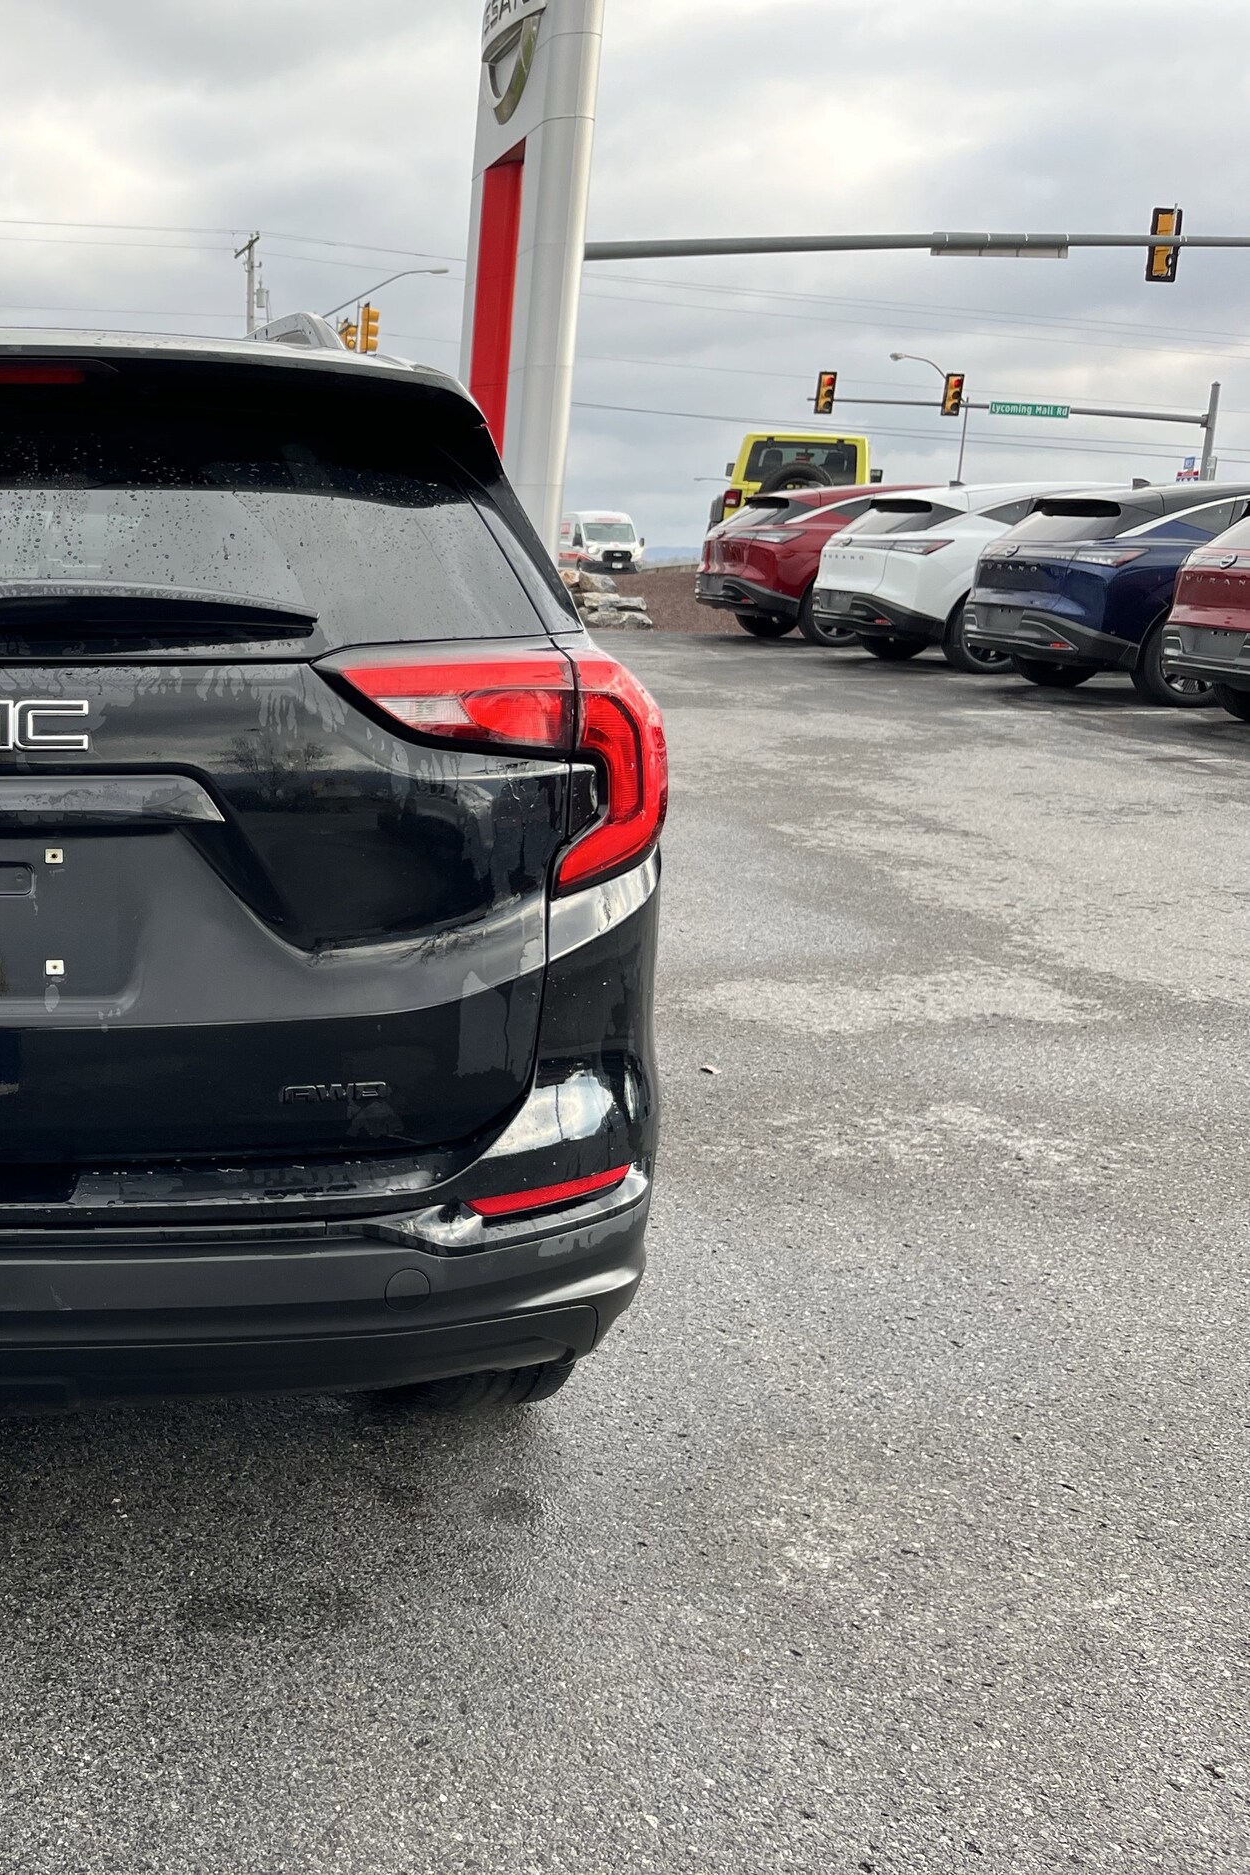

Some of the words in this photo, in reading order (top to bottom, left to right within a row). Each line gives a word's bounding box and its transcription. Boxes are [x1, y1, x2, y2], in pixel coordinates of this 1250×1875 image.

[992, 403, 1032, 415] Lycoming
[1035, 406, 1053, 415] Mall
[1056, 408, 1068, 416] Rd
[280, 1081, 390, 1103] AWD
